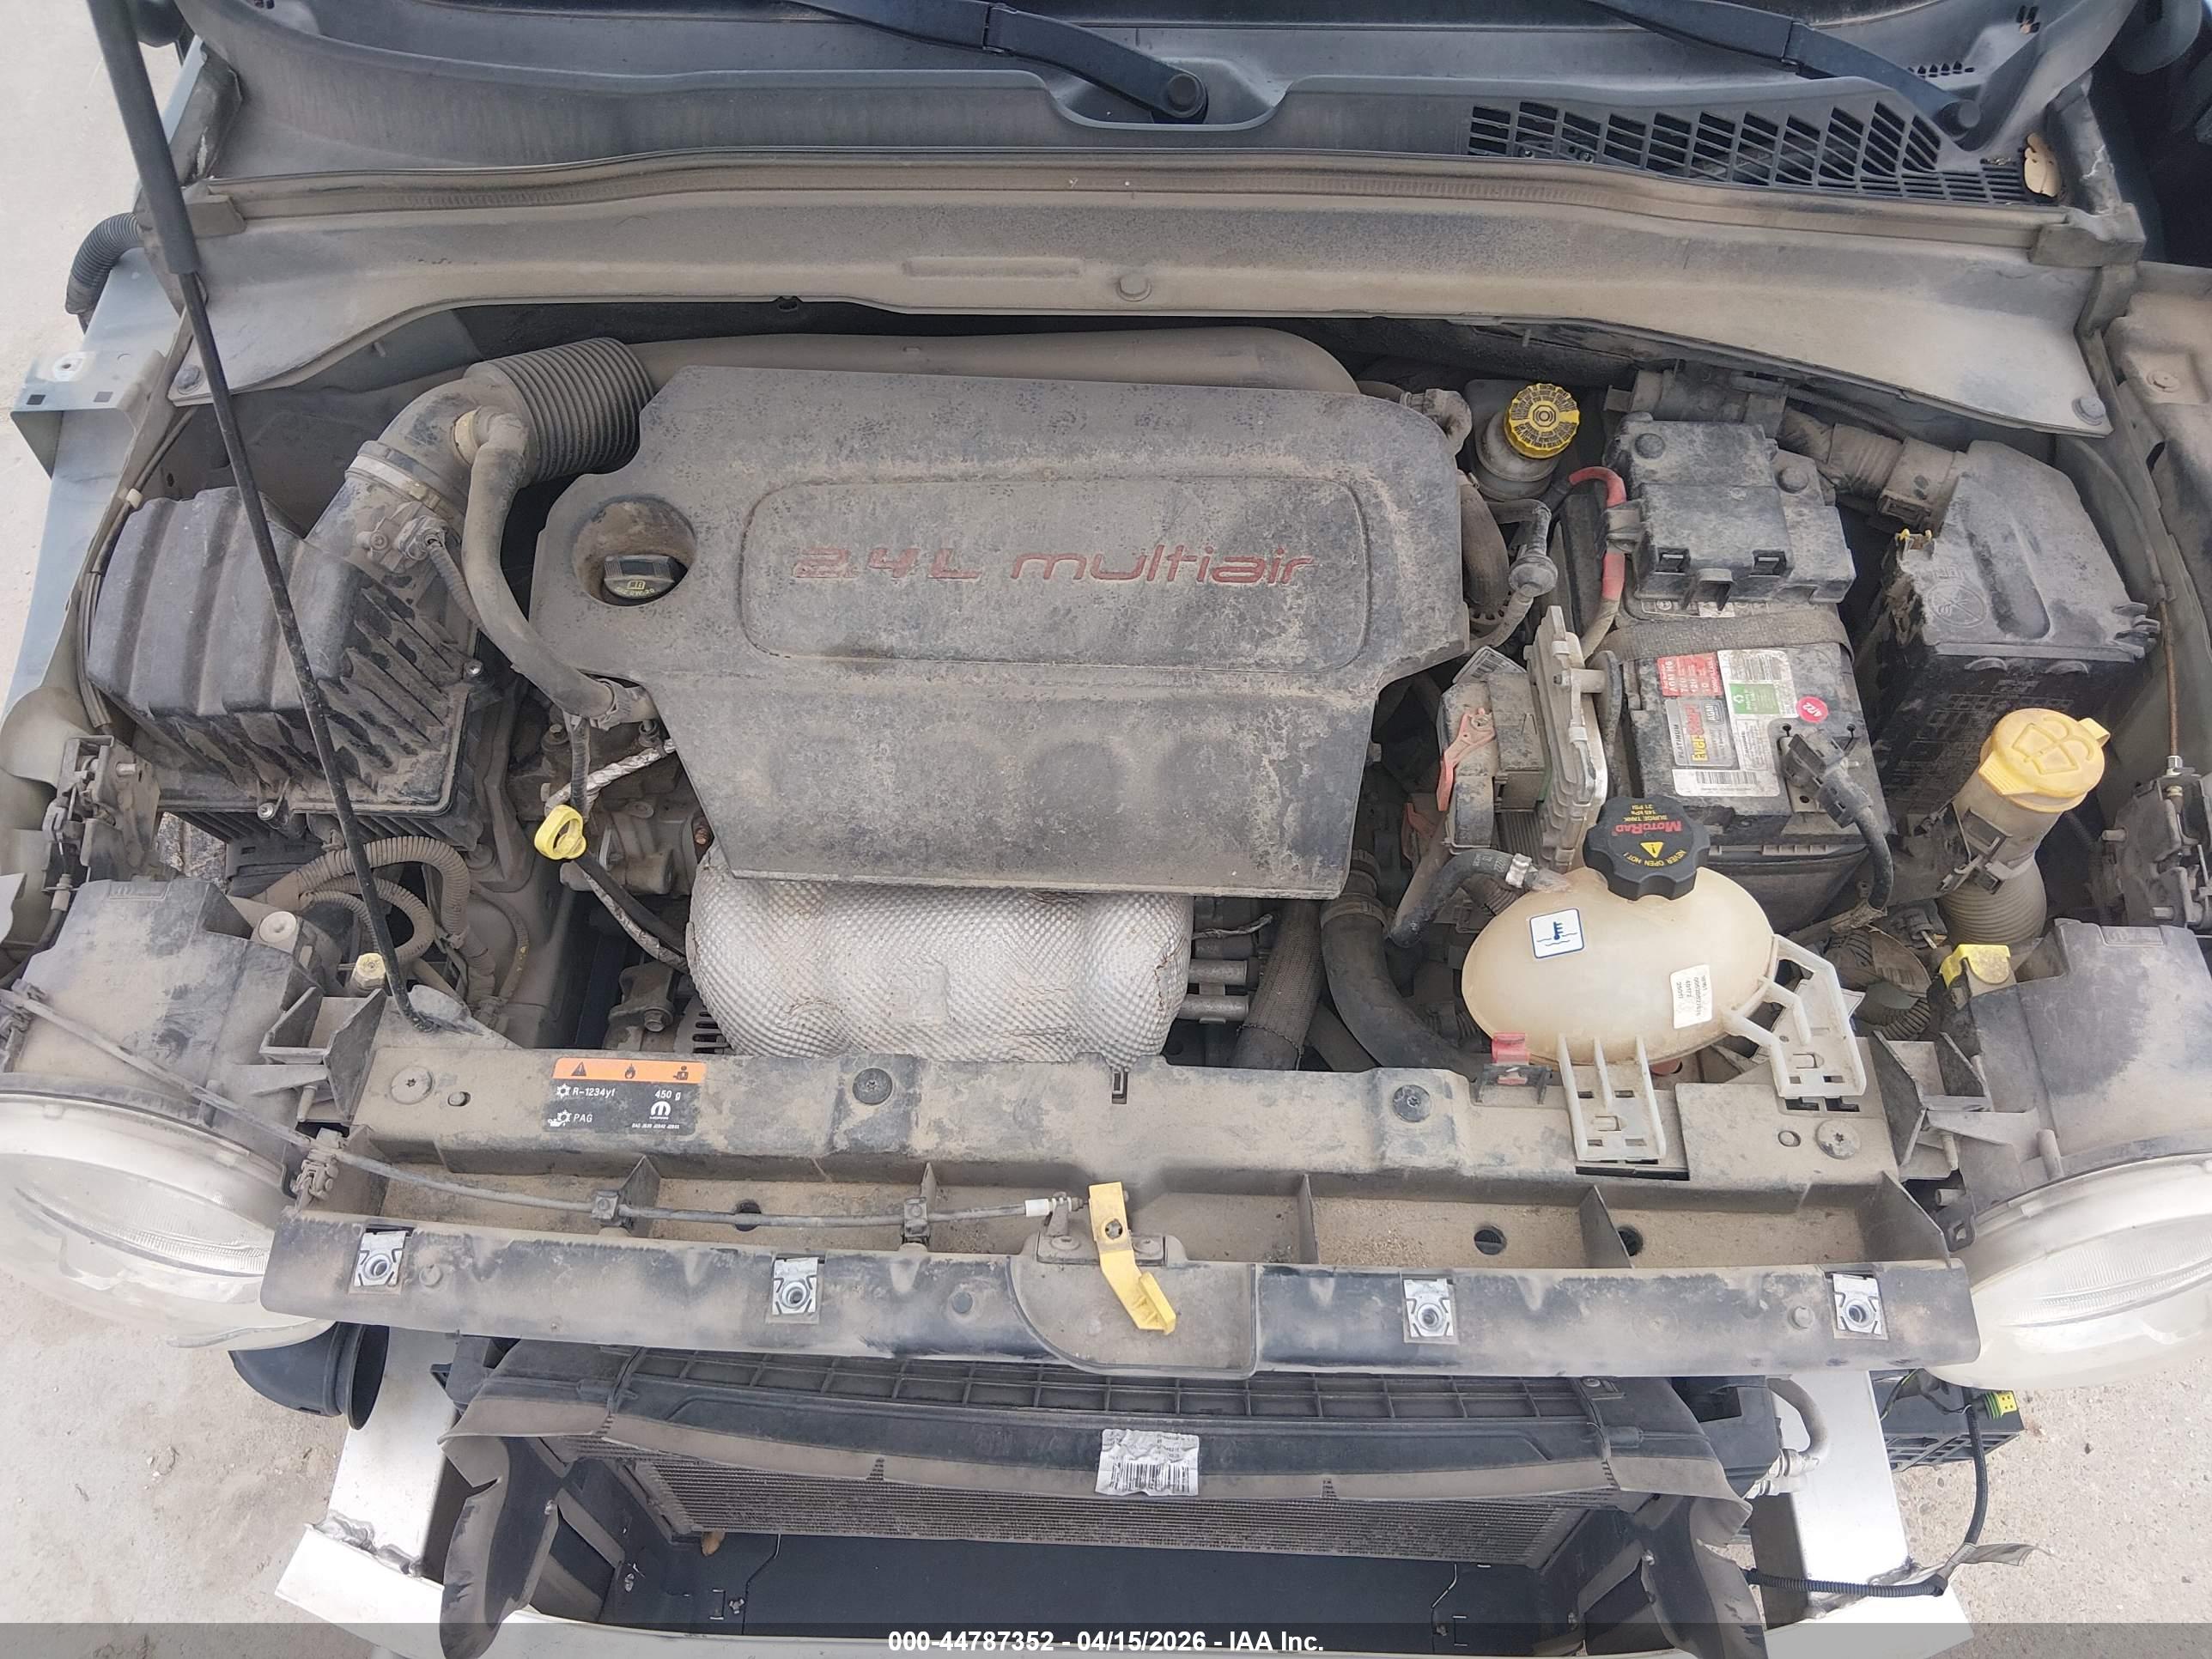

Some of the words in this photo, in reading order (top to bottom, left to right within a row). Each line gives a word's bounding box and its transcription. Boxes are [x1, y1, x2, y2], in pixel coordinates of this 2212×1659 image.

[1009, 544, 1316, 586] multiair
[1703, 704, 1717, 721] AGM
[1673, 724, 1684, 758] PLATINUM
[1627, 854, 1643, 865] HOT
[1666, 849, 1687, 865] NEVER
[572, 1086, 616, 1098] R-1234yf
[654, 1090, 672, 1099] 450
[675, 1091, 682, 1101] g
[573, 1113, 593, 1123] PAG
